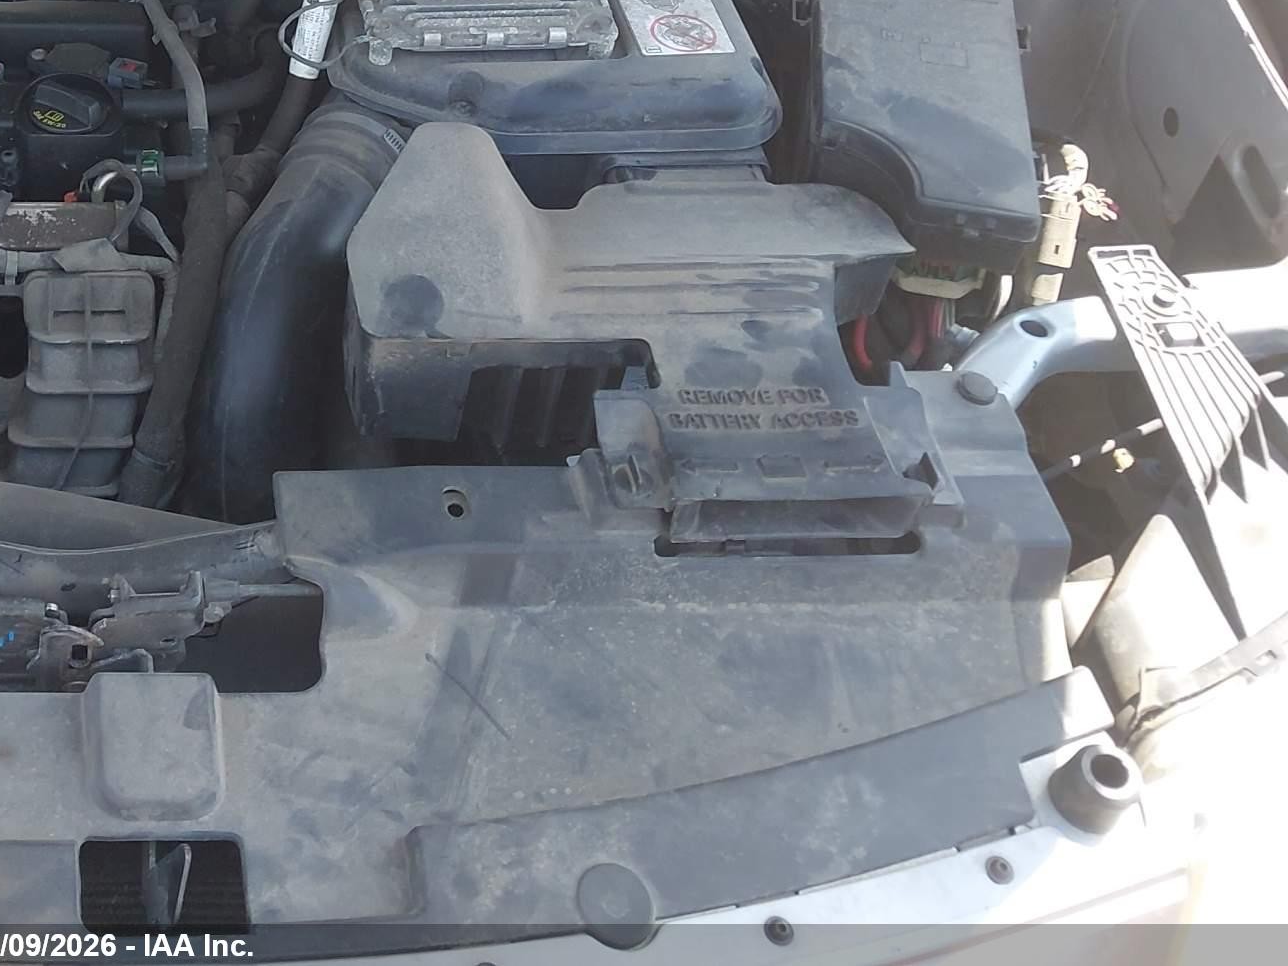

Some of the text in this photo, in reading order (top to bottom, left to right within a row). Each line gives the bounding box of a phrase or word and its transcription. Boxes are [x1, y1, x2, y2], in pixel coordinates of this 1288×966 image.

[677, 387, 826, 405] REMOVE FOR
[669, 409, 860, 430] BATTERY ACCESS
